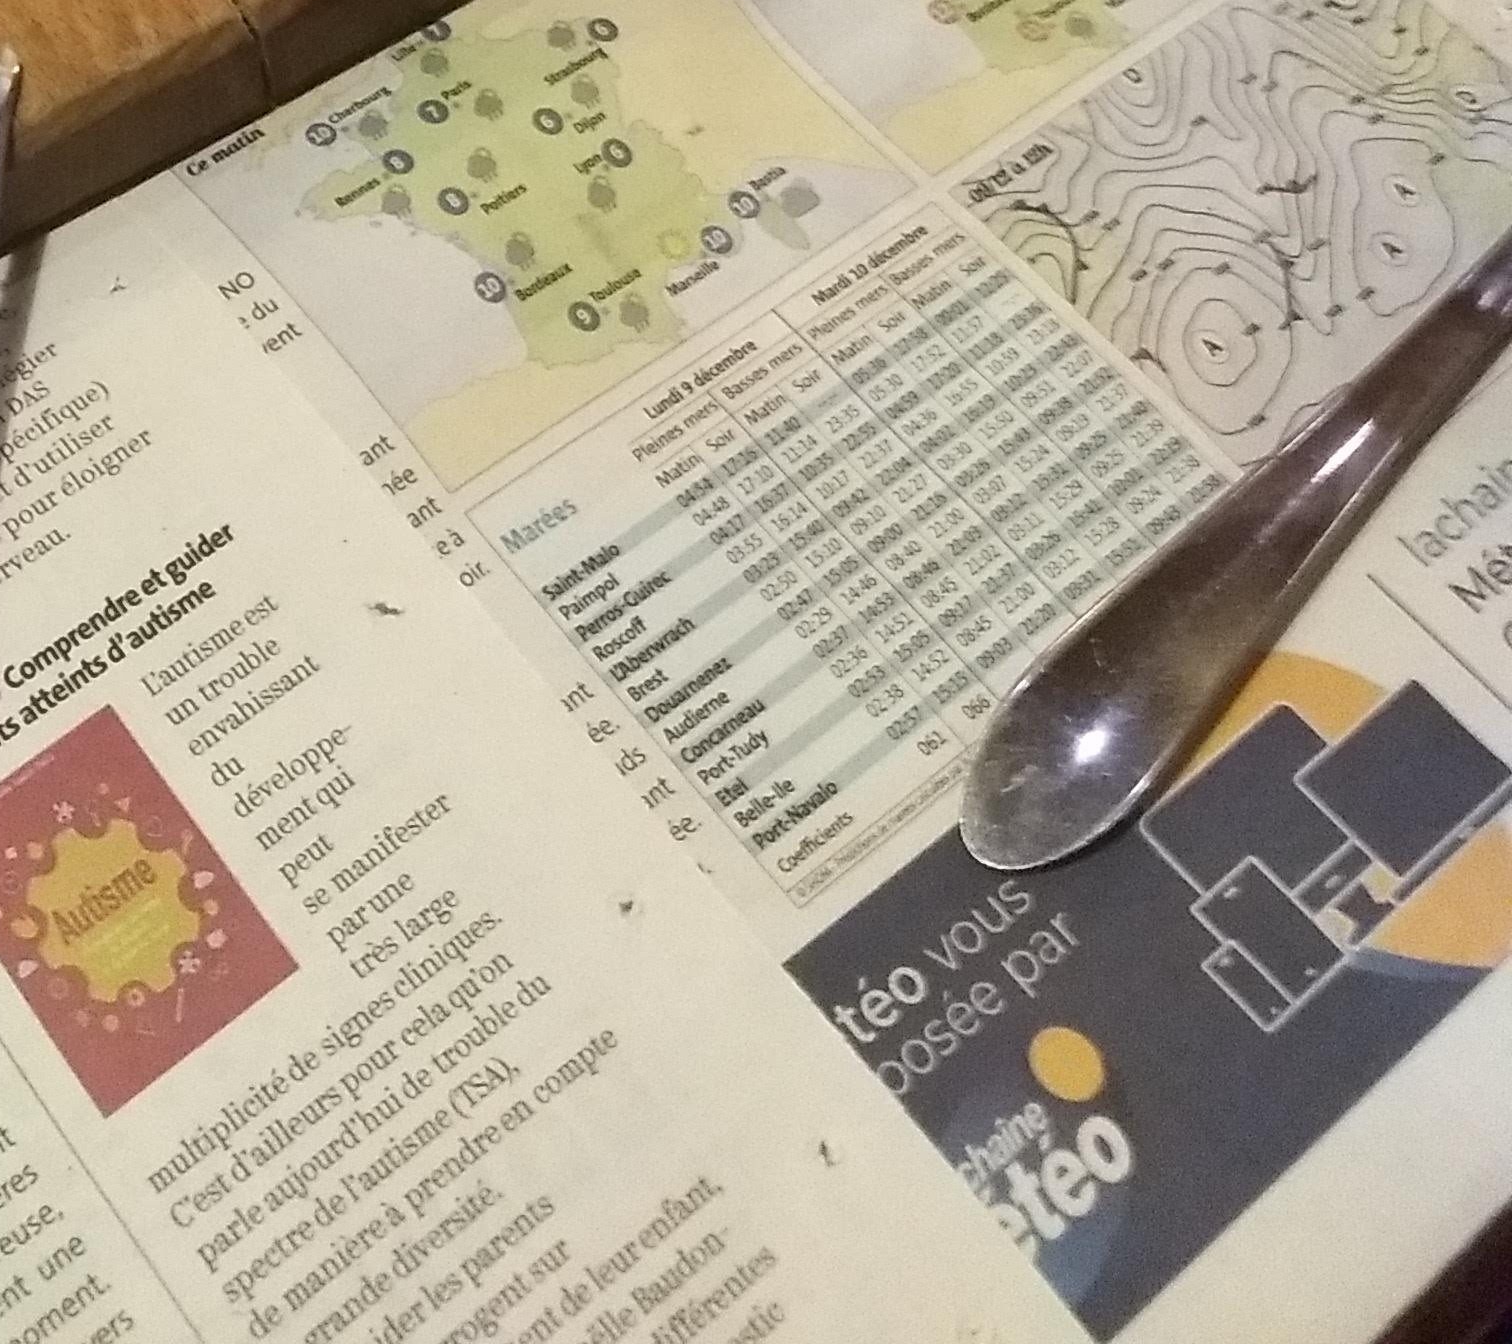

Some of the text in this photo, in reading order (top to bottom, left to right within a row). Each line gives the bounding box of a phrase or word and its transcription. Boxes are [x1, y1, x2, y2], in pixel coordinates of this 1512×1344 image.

[440, 79, 473, 101] Paris
[544, 47, 609, 87] Strasbourg
[327, 85, 392, 125] Cherbourg
[573, 112, 607, 135] Dijon
[186, 128, 266, 177] Ce matin
[573, 153, 603, 175] Lyon
[748, 165, 788, 193] Bastia
[334, 178, 381, 208] Rennes
[480, 183, 528, 216] Poitiers
[514, 263, 574, 302] Bordeaux
[588, 267, 643, 303] Toulouse
[666, 260, 720, 297] Marseille
[807, 233, 966, 341] Pleines mers Basses mers
[811, 226, 928, 306] Mardi 10 décembre
[831, 279, 952, 363] Matin Soir Matin
[6, 381, 51, 416] DAS
[631, 343, 803, 463] Pleines mers Basses mers
[643, 340, 758, 420] Lundi 9 décembre
[14, 411, 115, 486] d'utiliser
[655, 367, 822, 489] Matin Soir Matin Soir
[3, 487, 58, 542] pour
[60, 429, 154, 499] éloigner
[500, 497, 578, 554] Marées
[541, 543, 621, 601] Saint-Malo
[558, 573, 621, 622] Paimpol
[3, 521, 236, 690] Comprendre et guider
[245, 594, 280, 627] est
[574, 570, 673, 642] Perros-Guirec
[592, 615, 648, 662] Roscoff
[165, 636, 282, 726] un trouble
[610, 617, 696, 683] L'Aberwrach
[18, 655, 109, 727] atteints
[187, 652, 322, 758] envahissant
[626, 669, 669, 702] Brest
[645, 657, 734, 723] Douarnenez
[662, 690, 731, 745] Audierne
[680, 699, 767, 764] Concarneau
[697, 729, 769, 787] Port-Tudy
[232, 722, 354, 819] développe-
[714, 781, 749, 808] Etel
[254, 766, 356, 852] ment qui
[329, 790, 454, 894] manifester
[751, 779, 838, 850] Port-Navalo
[277, 832, 335, 890] peut
[777, 812, 855, 874] Coefficients
[51, 855, 158, 945] Autisme
[368, 870, 416, 912] une
[349, 885, 462, 980] très large
[924, 879, 1031, 972] vous
[1000, 912, 1080, 997] par
[146, 909, 504, 1196] multiplicité signes cliniques.
[168, 1168, 232, 1230] C'est
[231, 1086, 343, 1185] d'ailleurs
[400, 1003, 452, 1049] cela
[196, 1000, 519, 1273] parle aujourd'hui trouble
[282, 1026, 619, 1311] manière prendre compte
[220, 1218, 316, 1303] spectre
[461, 1194, 557, 1288] parents
